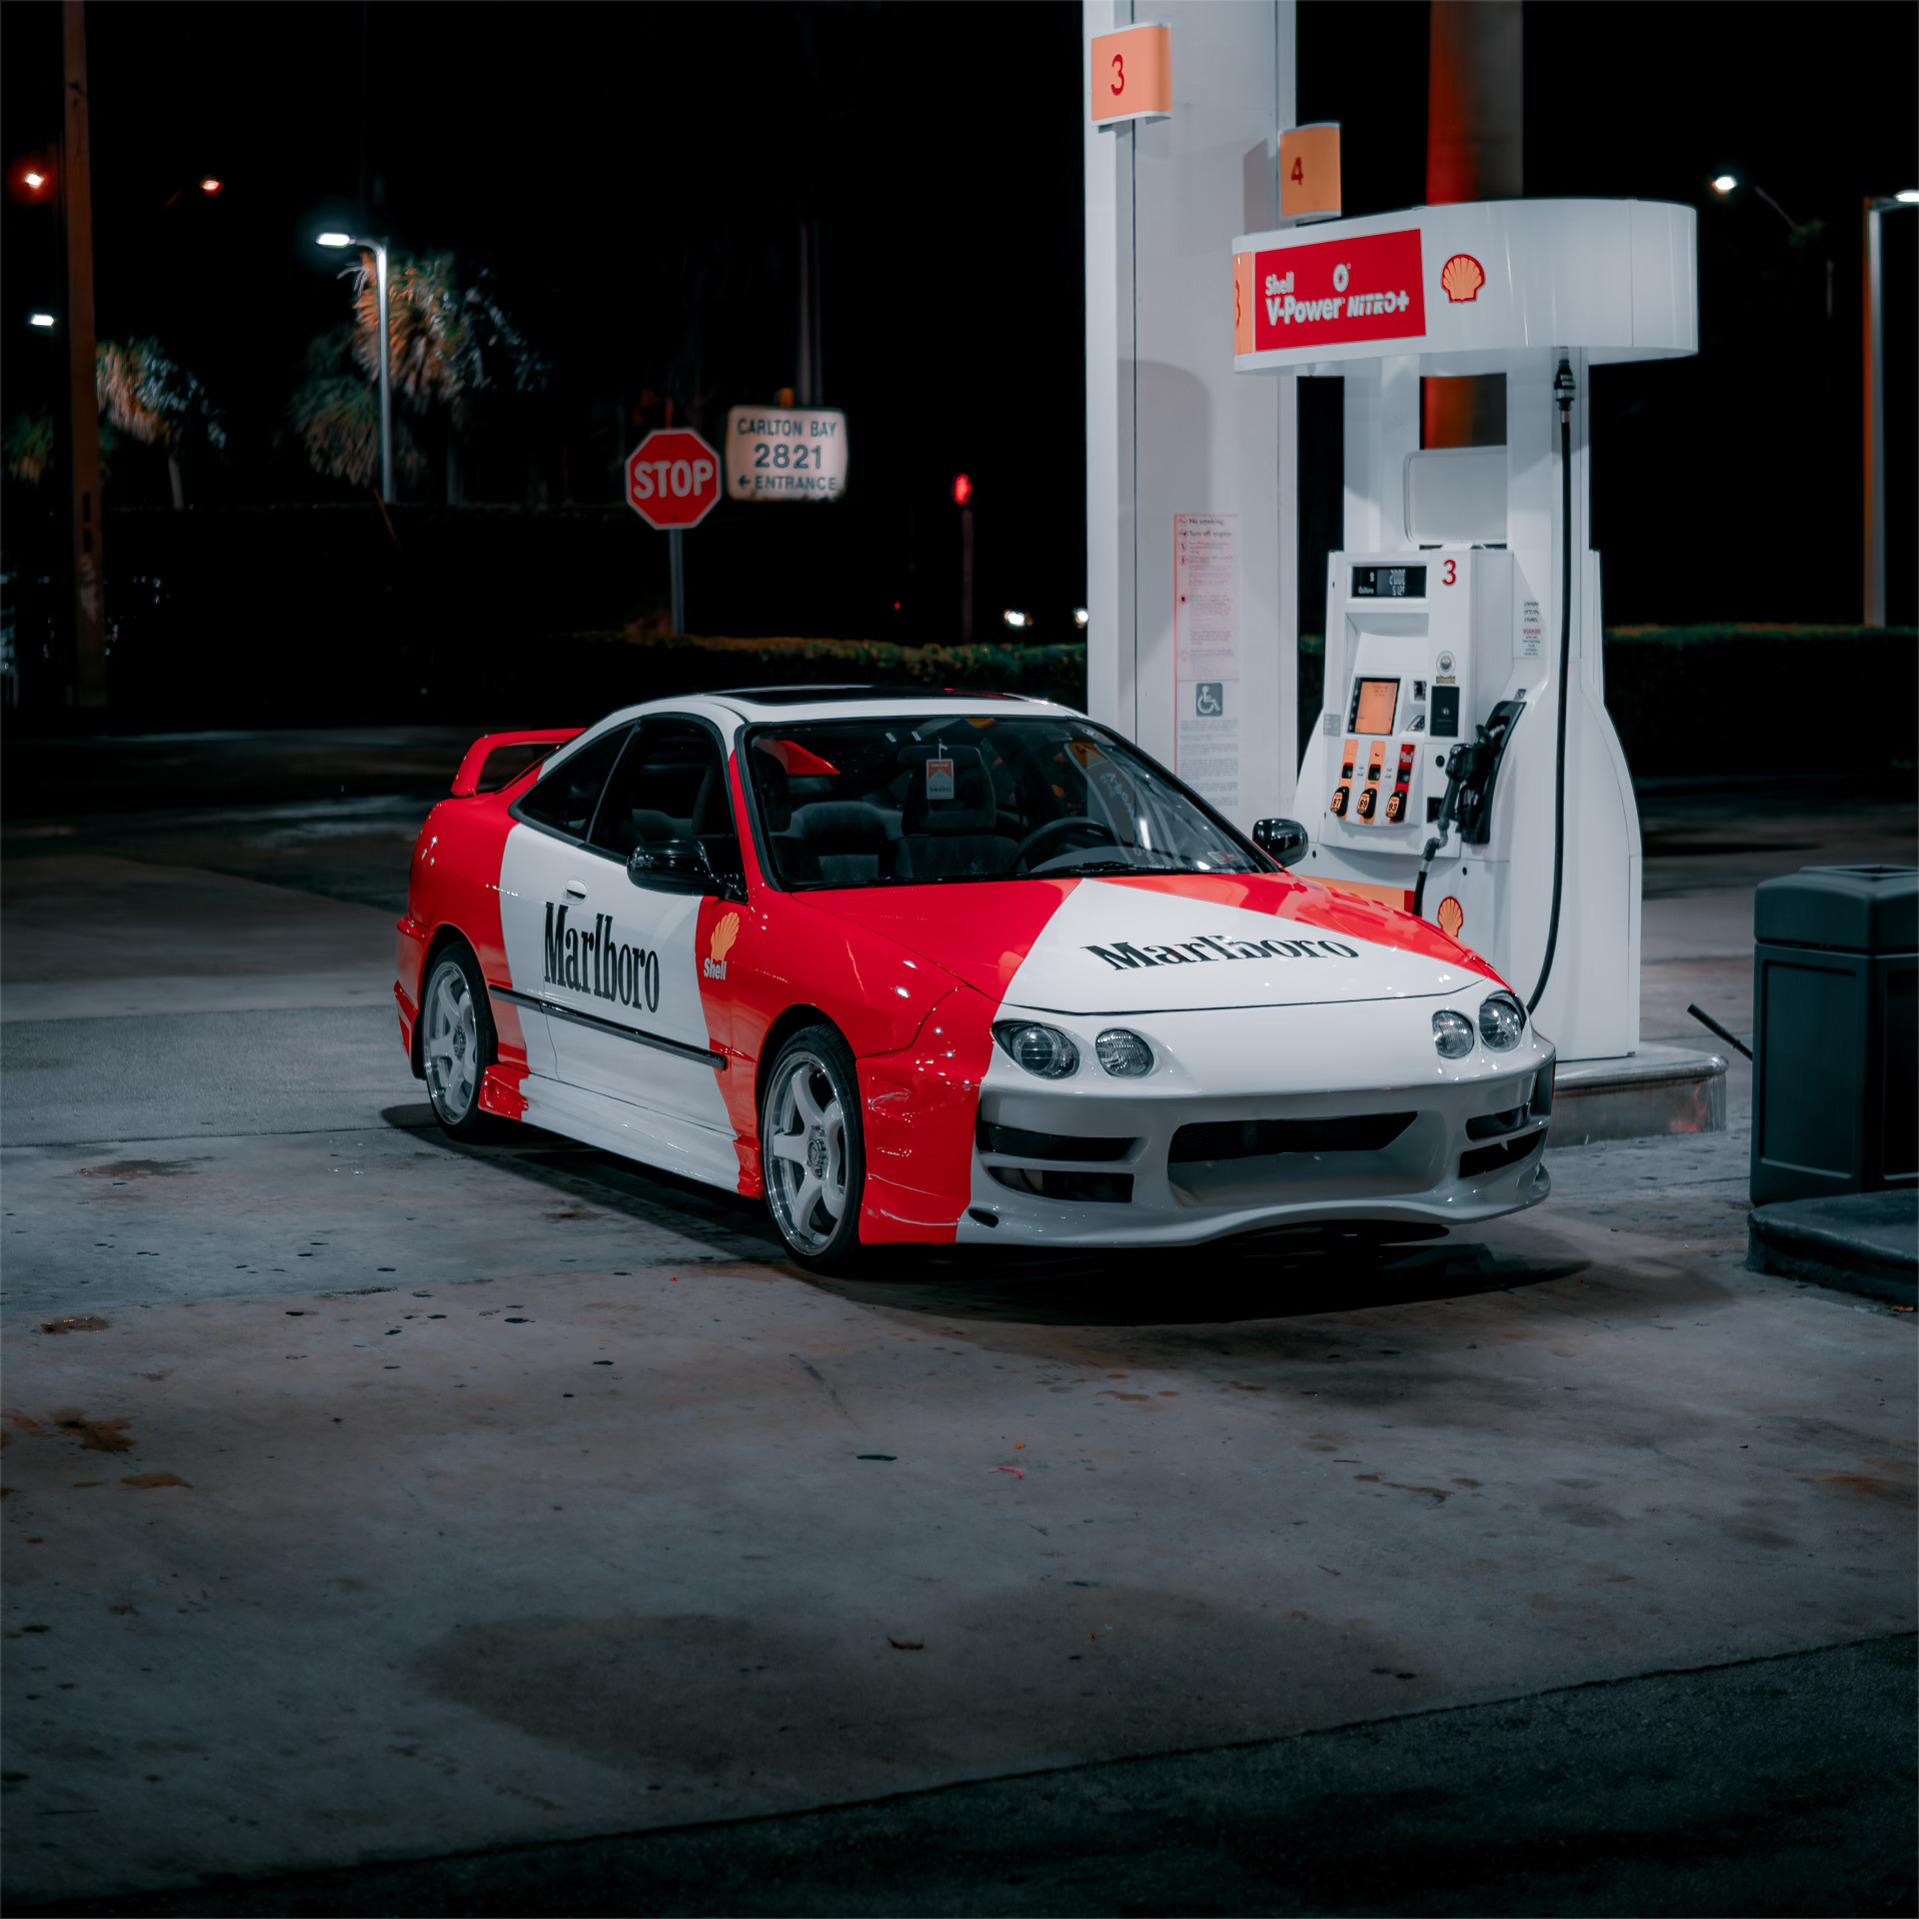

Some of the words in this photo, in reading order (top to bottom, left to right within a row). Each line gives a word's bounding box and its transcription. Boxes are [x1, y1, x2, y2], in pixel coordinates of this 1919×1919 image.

[1111, 54, 1125, 96] 3
[1291, 157, 1304, 185] 4
[1265, 271, 1295, 297] Shell
[1265, 295, 1344, 327] V-Power
[737, 417, 803, 436] CARLTON
[810, 420, 838, 438] BAY
[754, 443, 823, 470] 2821
[634, 459, 713, 499] STOP
[754, 475, 838, 491] ENTRANCE
[1442, 559, 1456, 587] 3
[544, 901, 660, 1013] Marlboro
[1080, 934, 1359, 971] Marlboro
[703, 956, 728, 981] Shell
